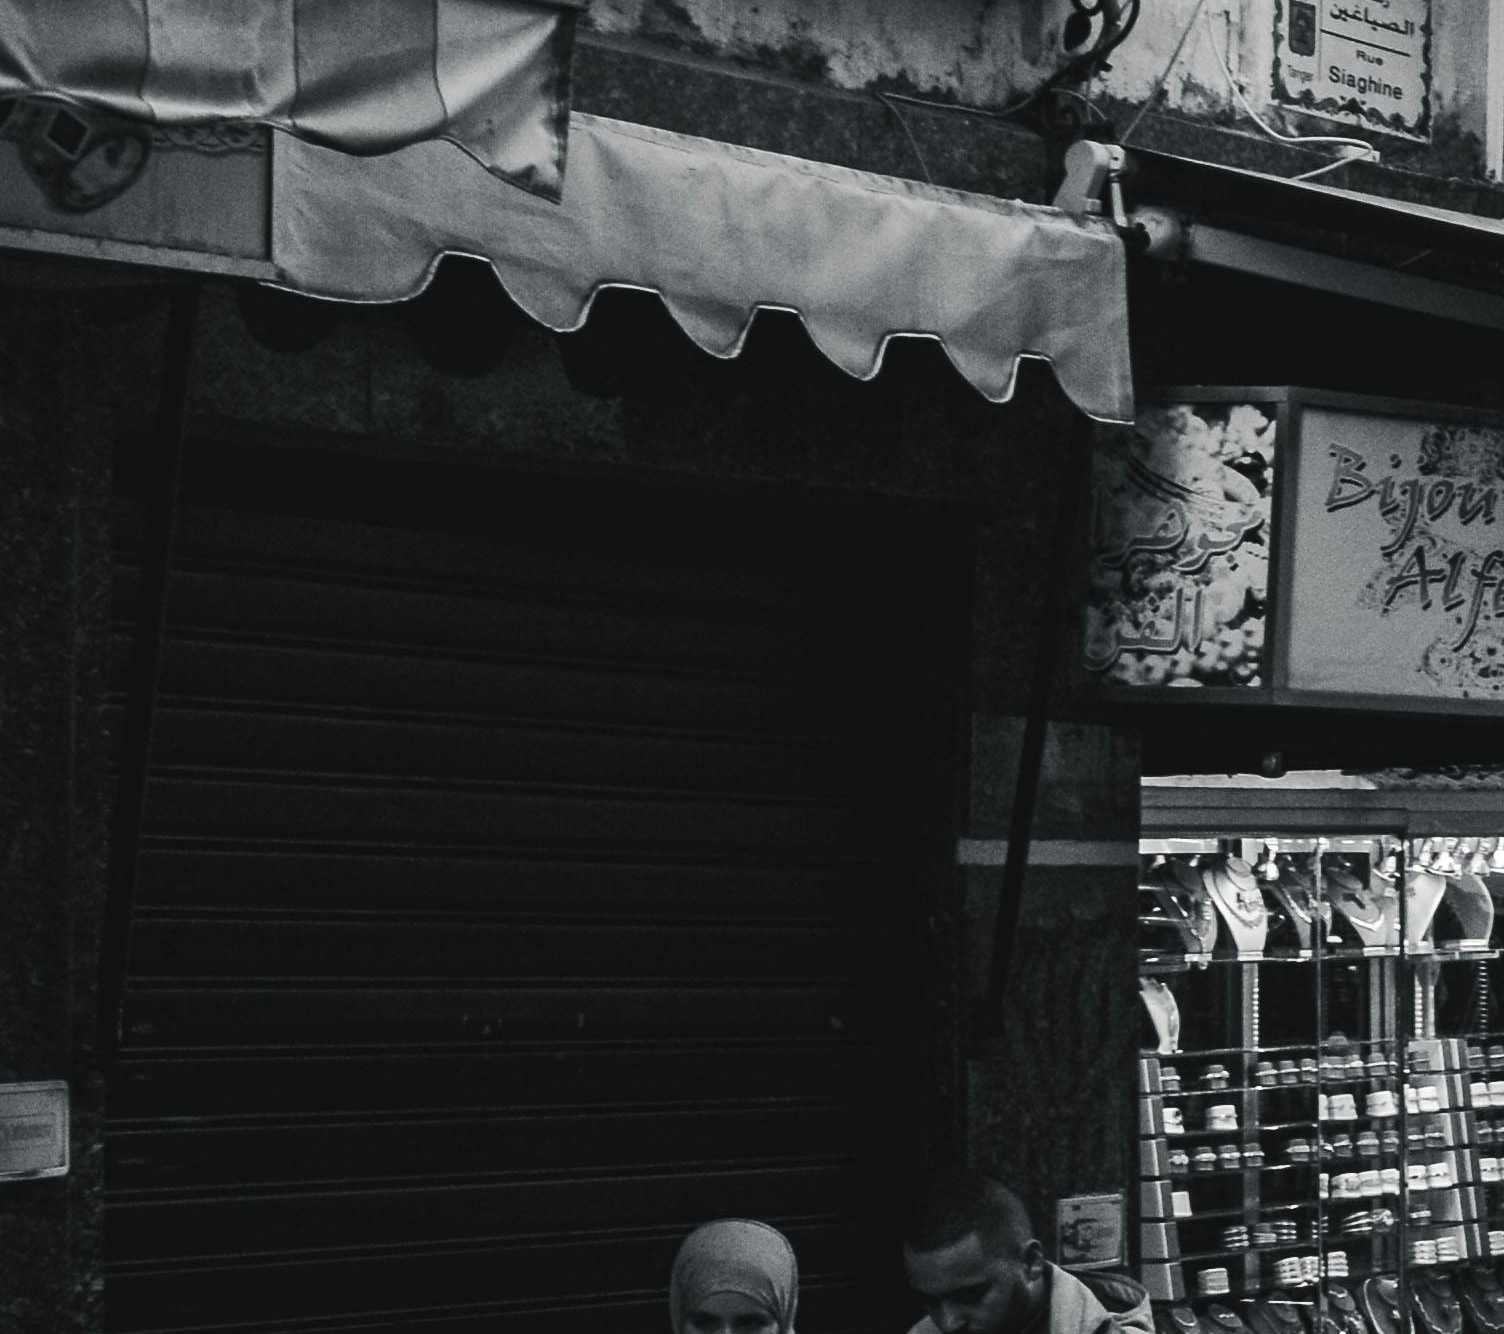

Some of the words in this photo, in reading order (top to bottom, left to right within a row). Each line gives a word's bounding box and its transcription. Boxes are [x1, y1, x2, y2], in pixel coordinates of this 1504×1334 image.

[1330, 2, 1415, 36] الصياغين
[1356, 49, 1384, 66] Rue
[1329, 66, 1403, 100] Siaghine
